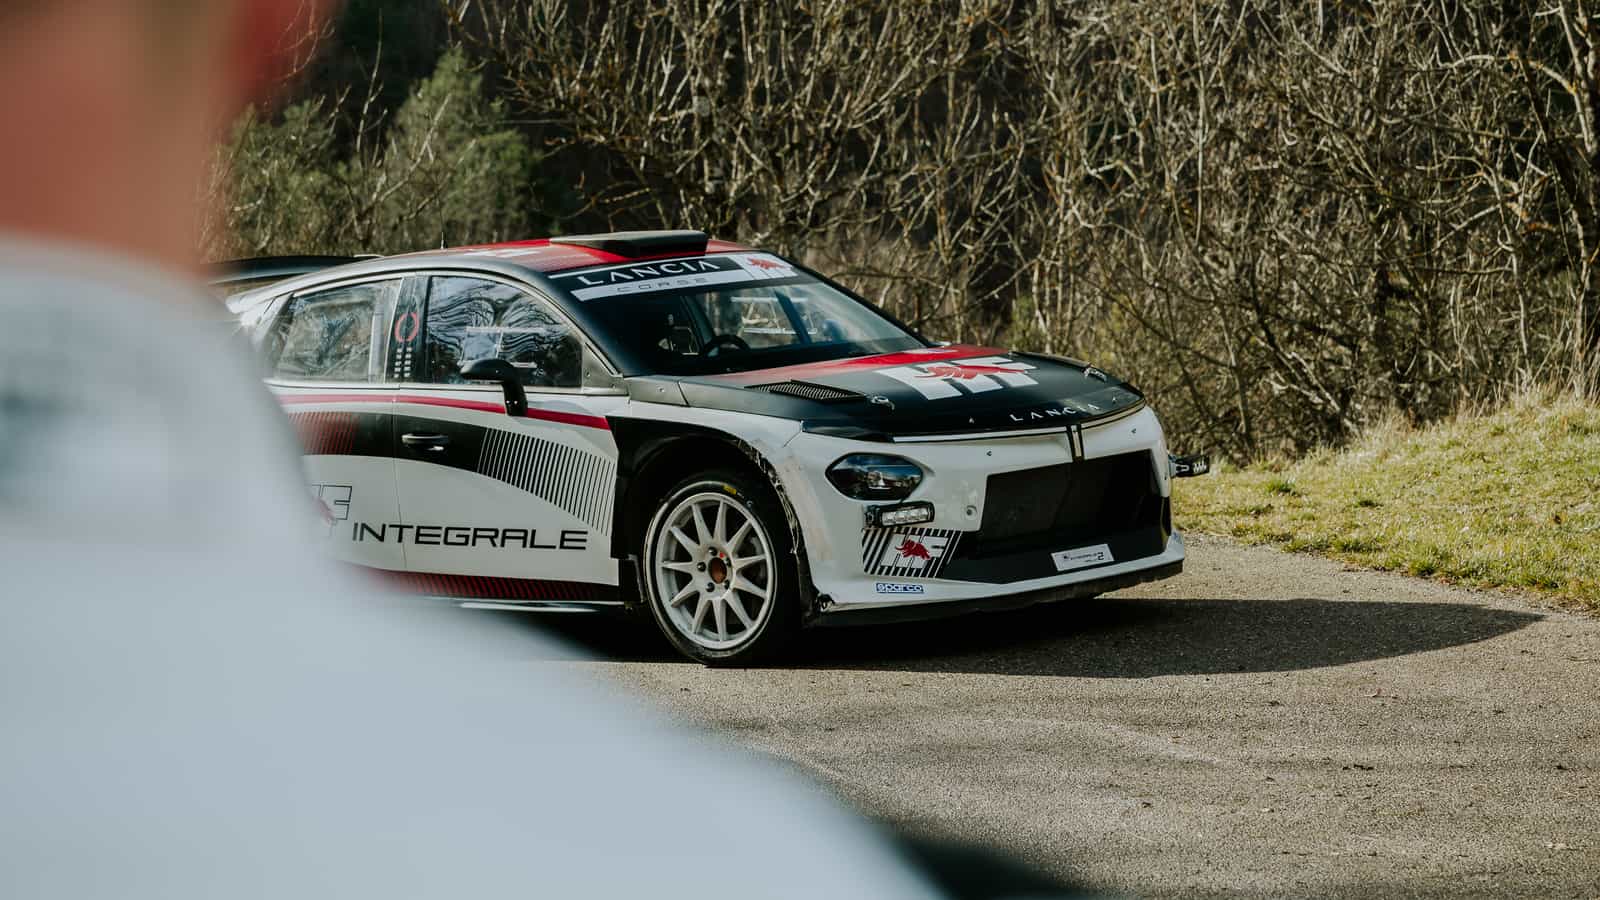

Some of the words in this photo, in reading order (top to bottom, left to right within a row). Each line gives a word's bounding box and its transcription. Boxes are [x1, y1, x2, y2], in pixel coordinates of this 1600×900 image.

[576, 257, 721, 286] LANCIA
[874, 355, 1040, 401] HF
[1009, 403, 1100, 422] LANCIA
[352, 522, 589, 551] INTEGRALE
[880, 533, 949, 569] HF
[876, 583, 925, 594] sparco
